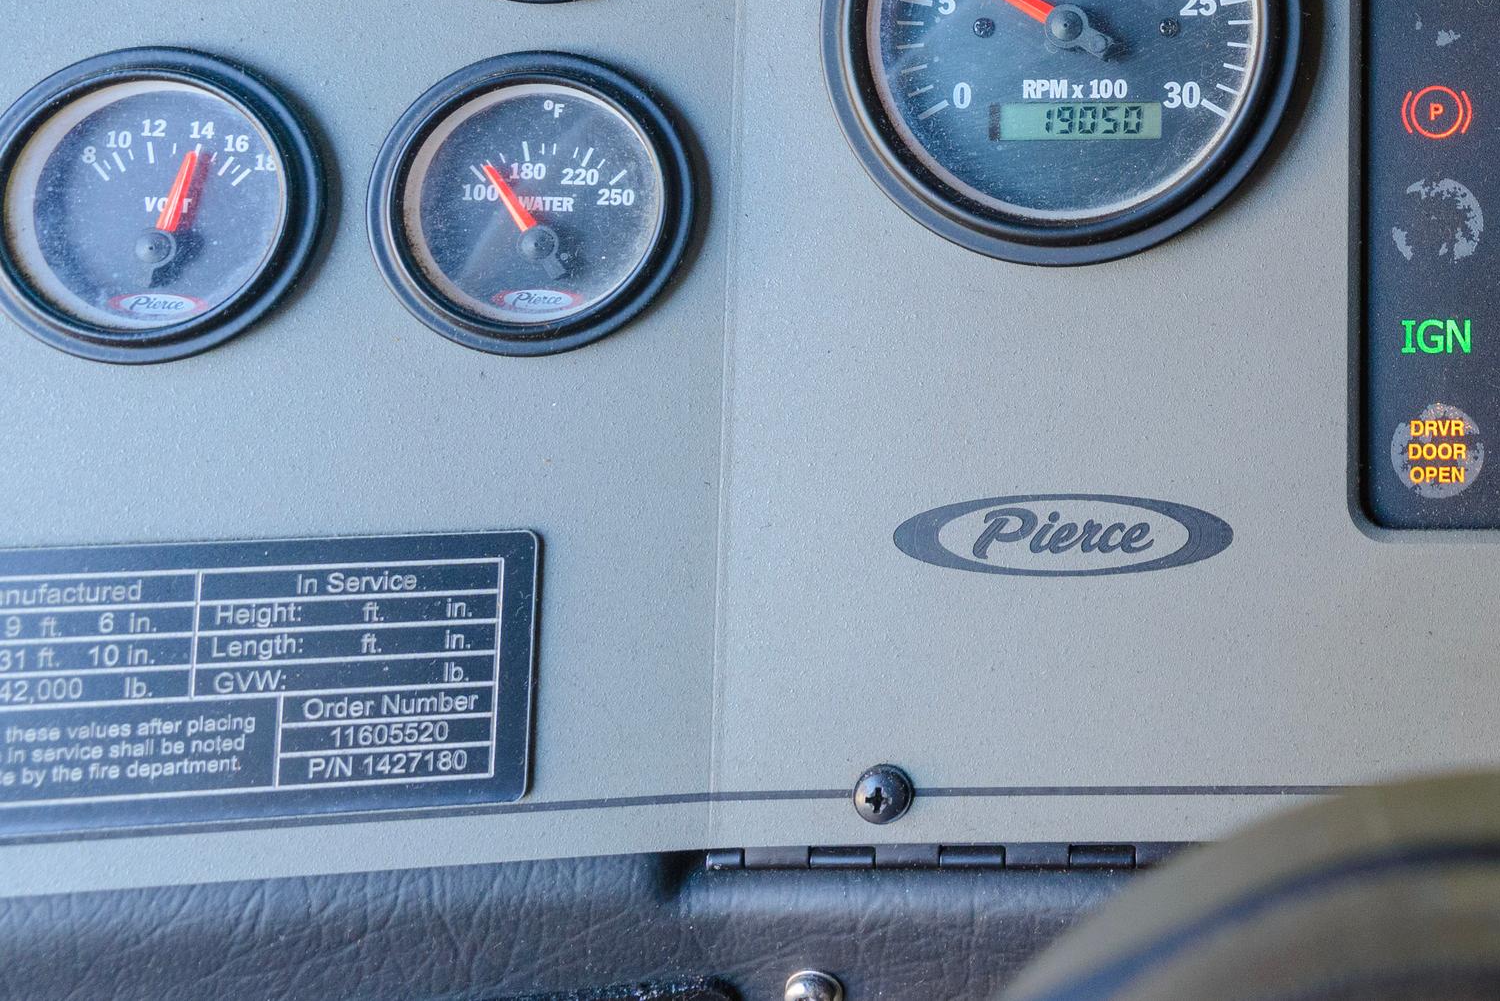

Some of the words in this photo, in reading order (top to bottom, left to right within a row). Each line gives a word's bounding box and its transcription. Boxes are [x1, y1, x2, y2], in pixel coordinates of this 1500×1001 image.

[953, 82, 972, 109] 0
[1022, 79, 1067, 99] RPM
[1072, 84, 1083, 99] x
[1090, 79, 1128, 99] 100
[1163, 82, 1200, 108] 30
[1045, 106, 1142, 134] 19050
[1430, 103, 1443, 121] P
[106, 131, 132, 148] 10
[141, 119, 167, 137] 12
[190, 121, 215, 139] 14
[82, 146, 96, 163] 8
[224, 135, 249, 152] 16
[255, 154, 277, 171] 18
[509, 163, 546, 180] 180
[561, 169, 599, 186] 220
[462, 184, 499, 201] 100
[519, 196, 574, 212] WATER
[597, 189, 635, 206] 250
[129, 296, 184, 310] Pierce
[512, 292, 562, 307] Pierce
[1401, 320, 1472, 353] IGN
[1410, 420, 1464, 437] DRVR
[1408, 443, 1466, 460] DOOR
[1409, 467, 1465, 484] OPEN
[972, 508, 1154, 560] Pierce
[0, 579, 142, 606] nufactured
[296, 574, 317, 595] In
[326, 570, 417, 594] Service
[6, 616, 21, 638] 9
[40, 617, 62, 637] ft.
[99, 612, 114, 633] 6
[129, 613, 157, 633] in.
[214, 602, 302, 628] Height:
[362, 602, 384, 622] ft.
[445, 598, 473, 618] in.
[38, 647, 60, 668] ft.
[89, 644, 119, 667] 10
[127, 645, 155, 665] in.
[212, 633, 303, 660] Length:
[360, 633, 382, 653] ft.
[444, 630, 471, 649] in.
[214, 669, 286, 693] GVW:
[443, 662, 469, 682] lb.
[0, 678, 82, 704] 42,000
[124, 677, 153, 698] lb.
[303, 697, 374, 719] Order
[381, 692, 478, 715] Number
[5, 726, 60, 743] these
[68, 722, 131, 741] values
[137, 718, 182, 737] after
[187, 715, 256, 736] placing
[331, 721, 449, 747] 11605520
[32, 743, 103, 763] service
[108, 738, 154, 758] shall
[161, 737, 184, 755] be
[191, 734, 245, 754] noted
[22, 767, 45, 788] by
[52, 764, 82, 783] the
[89, 762, 120, 780] fire
[126, 755, 241, 780] department.
[308, 757, 353, 778] P/N
[363, 750, 467, 776] 1427180
